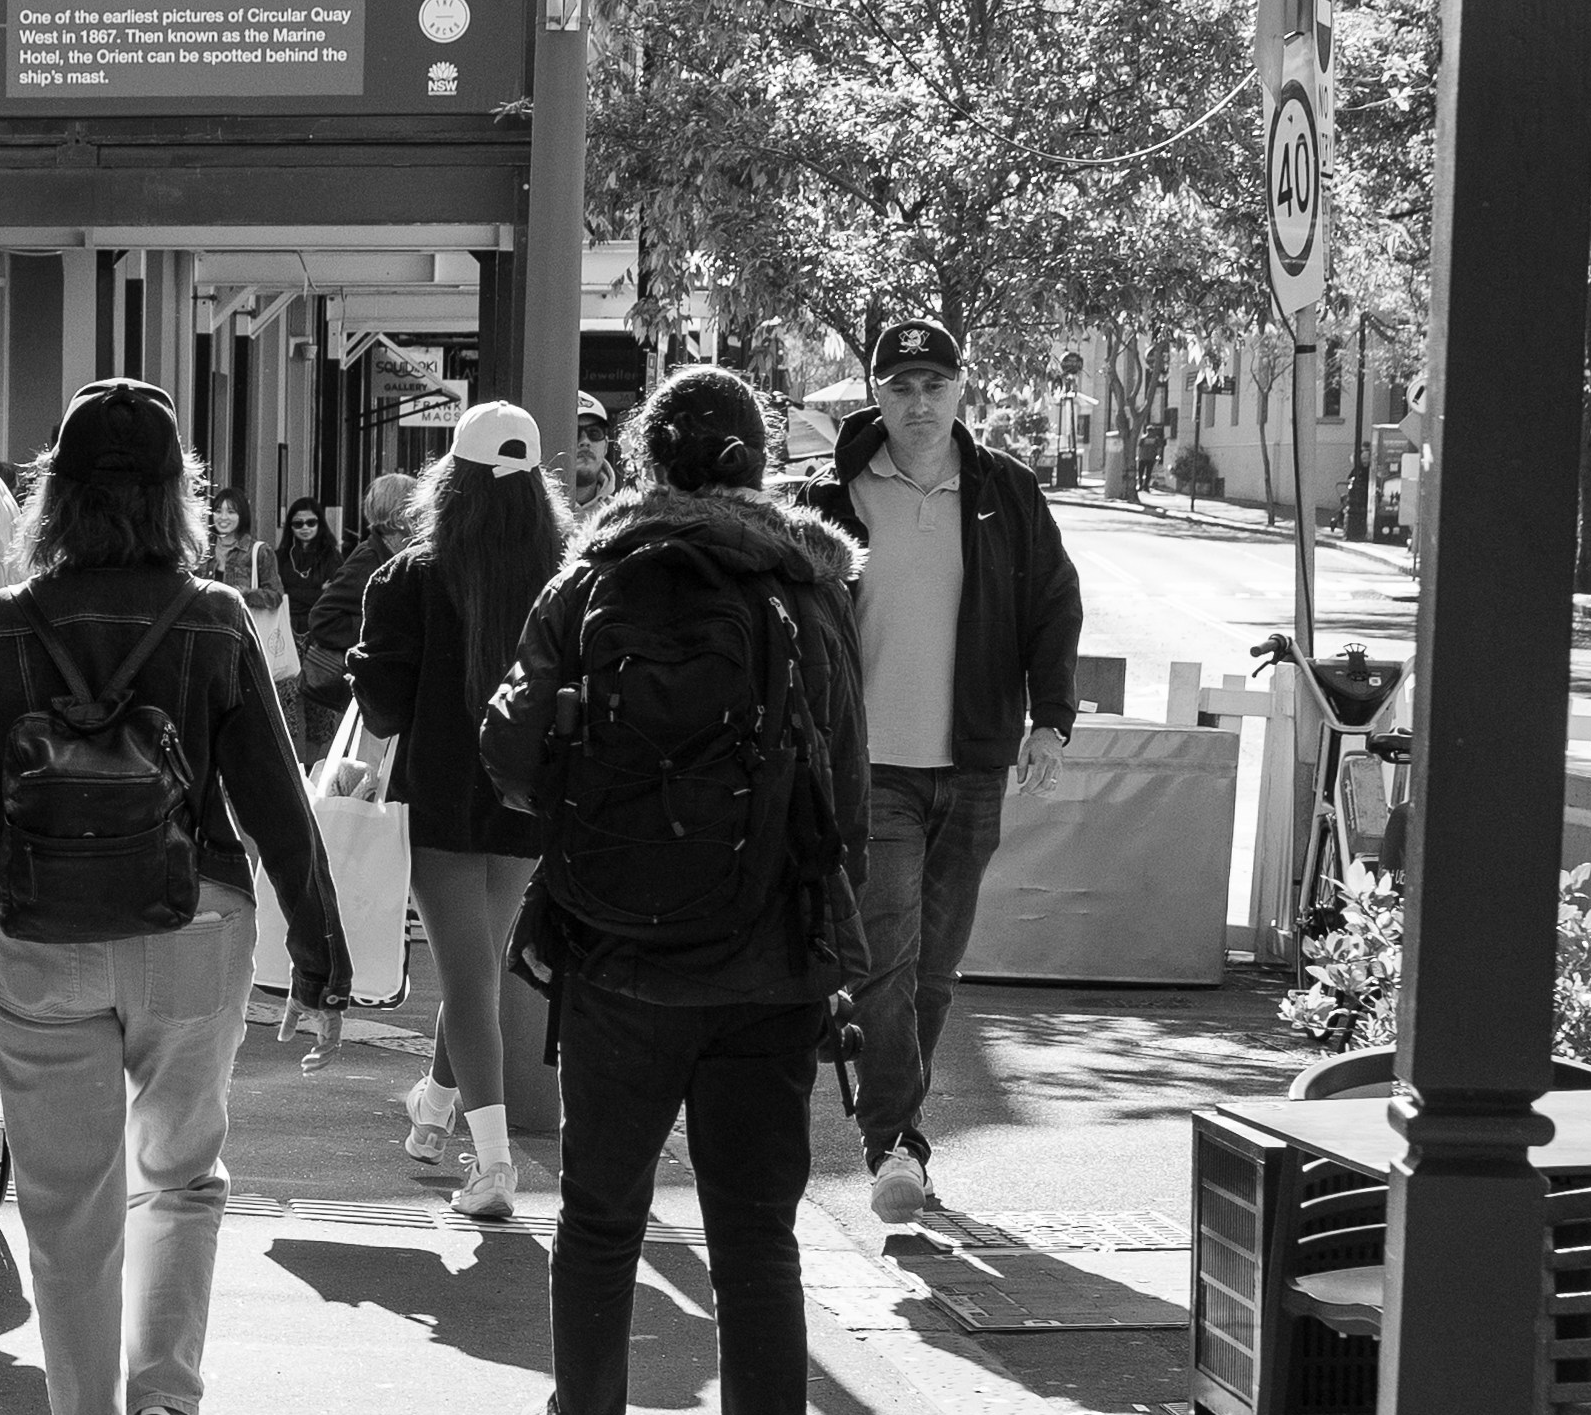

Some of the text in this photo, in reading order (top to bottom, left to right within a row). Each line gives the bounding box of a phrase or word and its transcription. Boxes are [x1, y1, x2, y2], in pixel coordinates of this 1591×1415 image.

[19, 6, 350, 26] One of the earliest pictures of Circular Quay
[19, 27, 325, 44] West in 1867. Then known as the Marine
[19, 47, 347, 66] Hotel, the Orient can be spotted behind the
[19, 69, 109, 87] ship's mast.
[428, 80, 458, 91] NSW
[1318, 84, 1329, 119] NO
[1277, 132, 1311, 217] 40
[384, 383, 427, 392] GALLERY
[413, 400, 462, 411] FRANK
[421, 412, 461, 422] MACS
